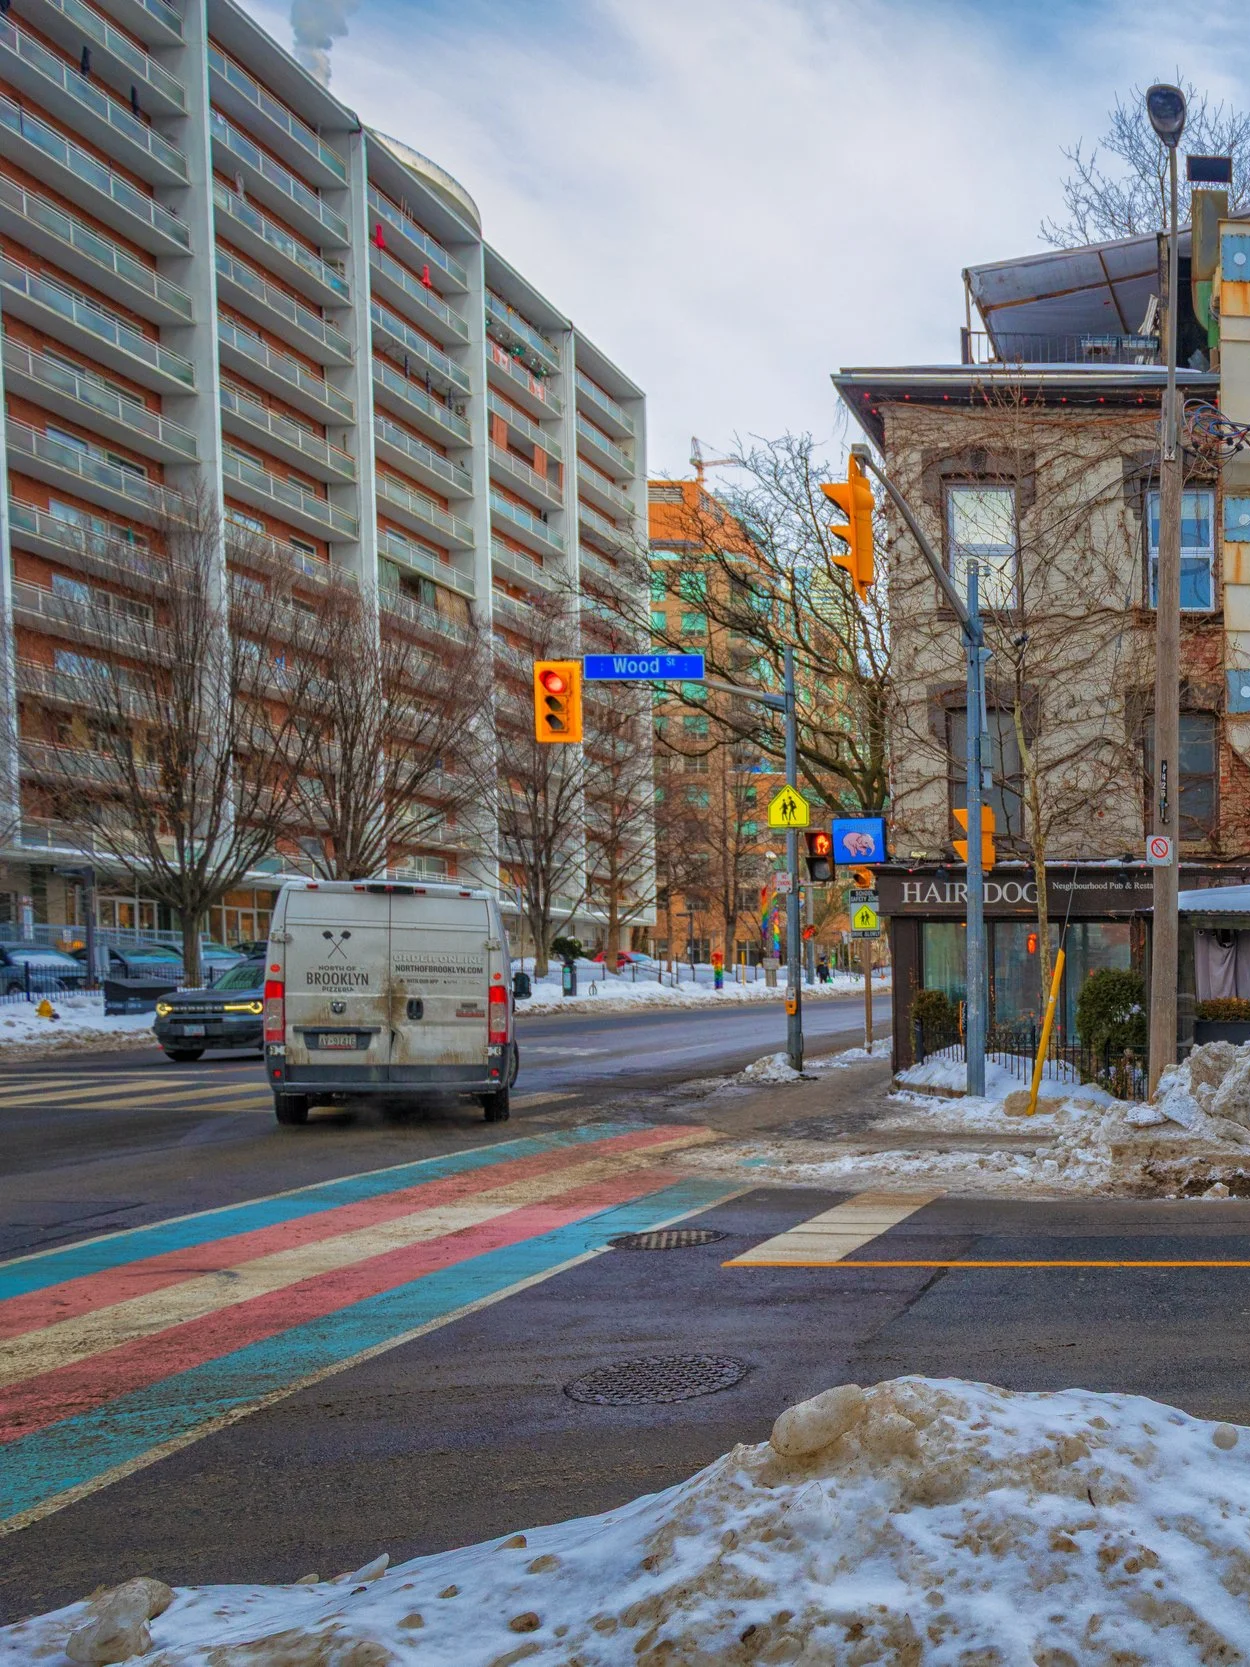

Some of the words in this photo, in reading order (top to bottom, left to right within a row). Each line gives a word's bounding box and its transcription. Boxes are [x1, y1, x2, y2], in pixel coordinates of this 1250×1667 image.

[613, 657, 659, 673] Wood
[666, 657, 675, 666] St
[1052, 881, 1107, 891] Neighbourhood
[1109, 882, 1123, 890] Pub
[901, 882, 968, 903] HAIR
[983, 882, 1039, 903] DOG
[393, 953, 436, 963] ORDER
[439, 954, 484, 964] ONLINE
[395, 964, 483, 974] NORTHOFBROOKLYN.COM
[306, 972, 369, 985] BROOKLYN
